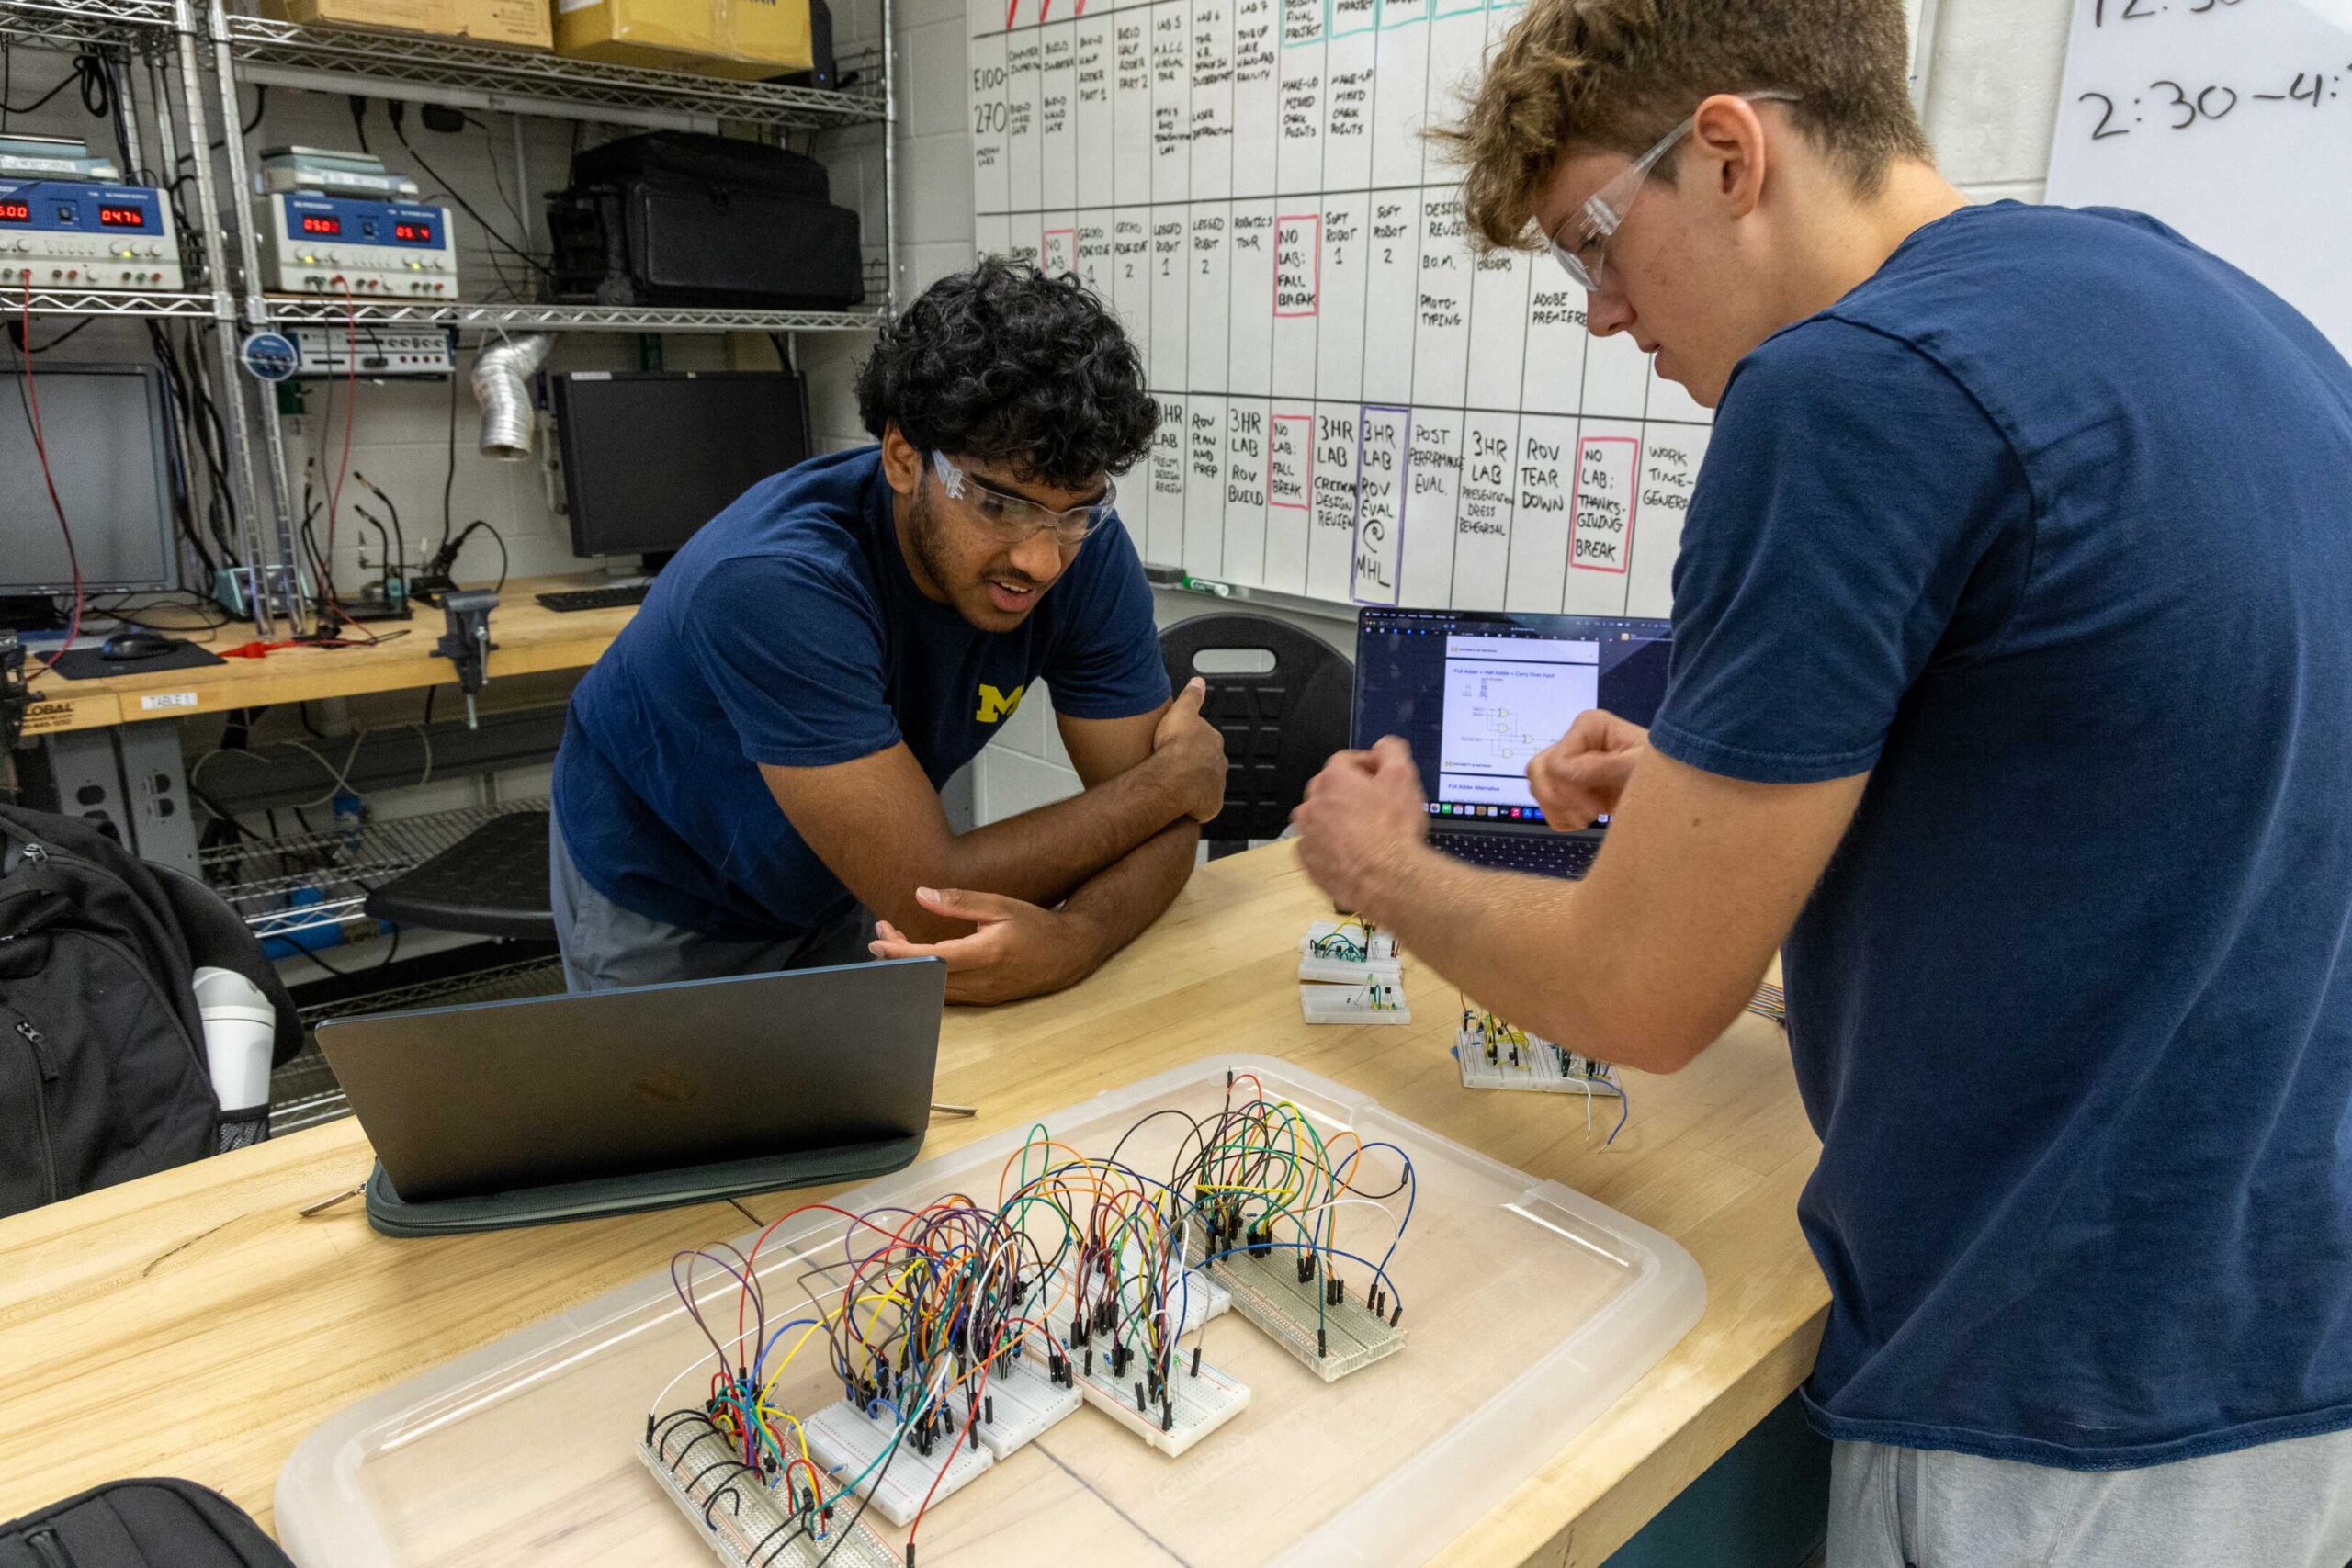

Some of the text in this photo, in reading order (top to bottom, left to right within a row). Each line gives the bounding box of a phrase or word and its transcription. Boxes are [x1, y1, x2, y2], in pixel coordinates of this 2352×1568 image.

[1285, 24, 1322, 39] PROJECT
[974, 101, 1007, 134] 270
[1279, 229, 1298, 245] NO
[1384, 247, 1394, 265] 2
[1125, 264, 1134, 278] 2
[1202, 259, 1210, 275] 2
[1278, 274, 1306, 288] FALL
[1278, 292, 1317, 307] BREAK
[1532, 291, 1568, 308] ADOBE
[1421, 311, 1461, 327] TYPING
[1229, 408, 1261, 435] 3HR
[1319, 416, 1354, 444] 3HR
[1415, 424, 1451, 445] POST
[1231, 439, 1259, 458] LAB
[1317, 446, 1348, 468] LAB
[1472, 430, 1508, 463] 3HR
[1526, 437, 1560, 462] ROV
[1585, 448, 1603, 463] NO
[1649, 444, 1689, 467] WORK
[1363, 449, 1392, 471] LAB
[1231, 464, 1258, 483] ROV
[1471, 465, 1502, 486] LAB
[1521, 466, 1559, 489] TEAR
[1228, 484, 1264, 507] BUILD
[1363, 477, 1392, 498] ROV
[1521, 490, 1564, 513] DOWN
[1575, 538, 1616, 563] BREAK
[1357, 553, 1392, 588] MHL
[976, 683, 1024, 723] M
